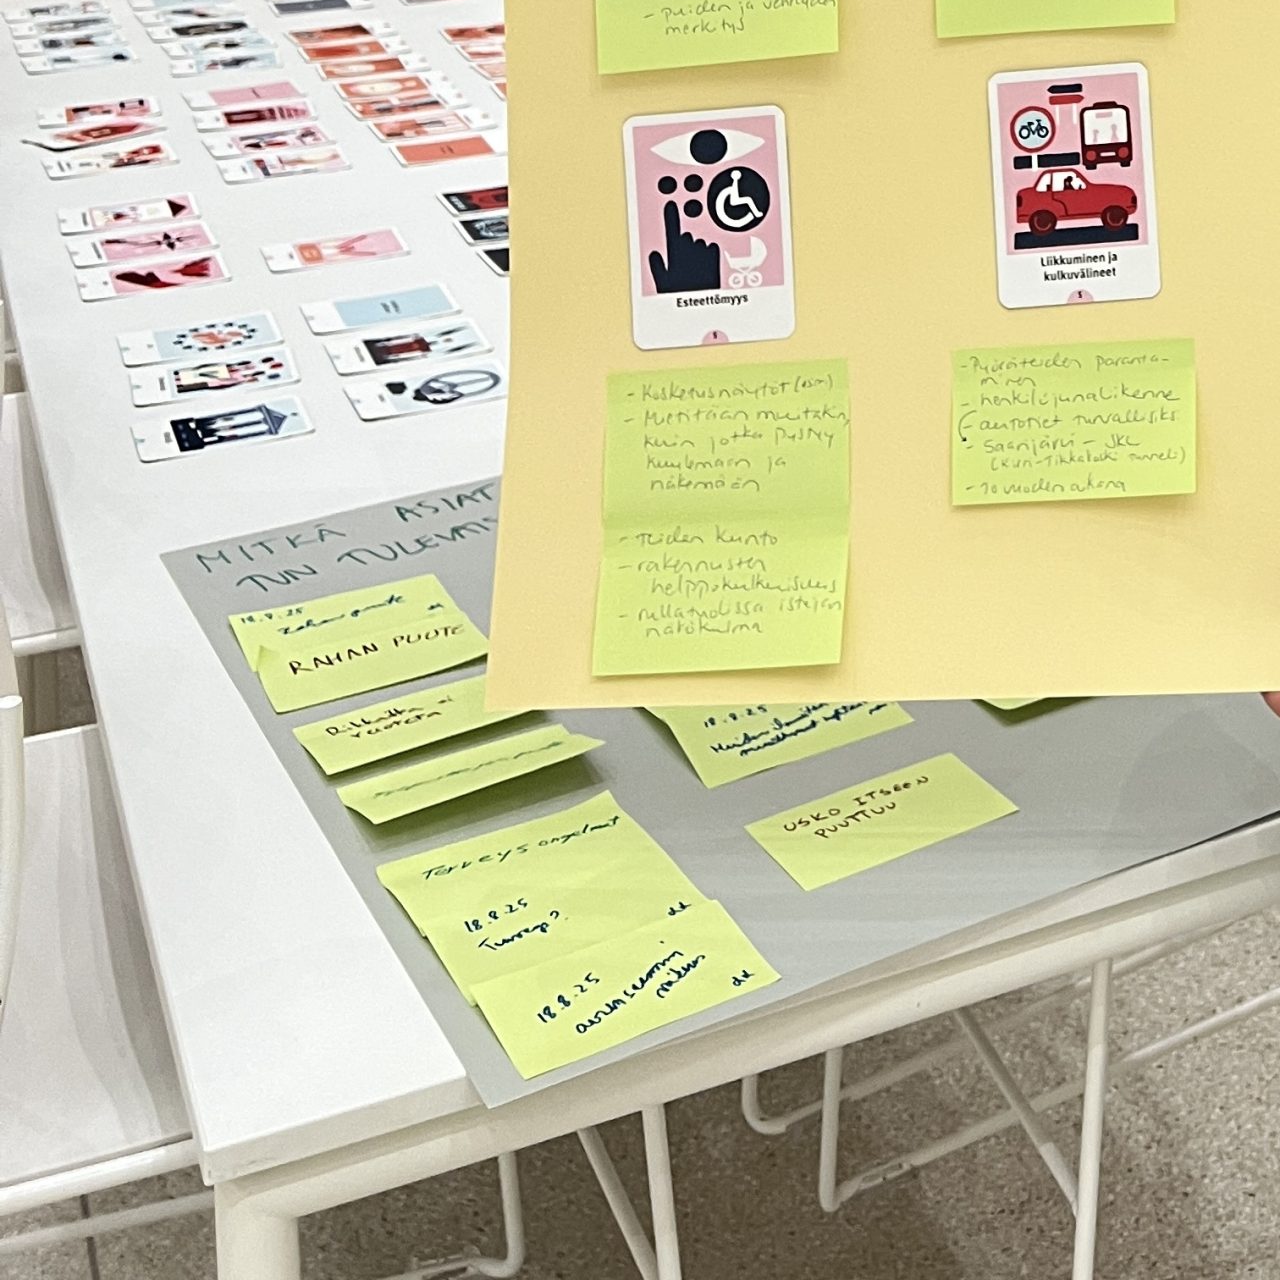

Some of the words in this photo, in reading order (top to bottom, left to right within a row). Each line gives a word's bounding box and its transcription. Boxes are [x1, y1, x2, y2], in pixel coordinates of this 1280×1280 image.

[738, 0, 755, 17] ja
[1040, 254, 1105, 267] Liikkuminen
[1107, 252, 1119, 265] ja
[1043, 267, 1117, 282] kulkuvälineet
[676, 294, 749, 308] Esteettömyys
[196, 523, 347, 574] MITKÄ
[394, 482, 496, 523] ASIAT
[287, 642, 379, 676] RAHAN
[392, 624, 467, 649] PUUTE
[783, 807, 841, 832] USKO
[464, 897, 529, 933] 18.8.25
[536, 971, 600, 1024] 18.8.25
